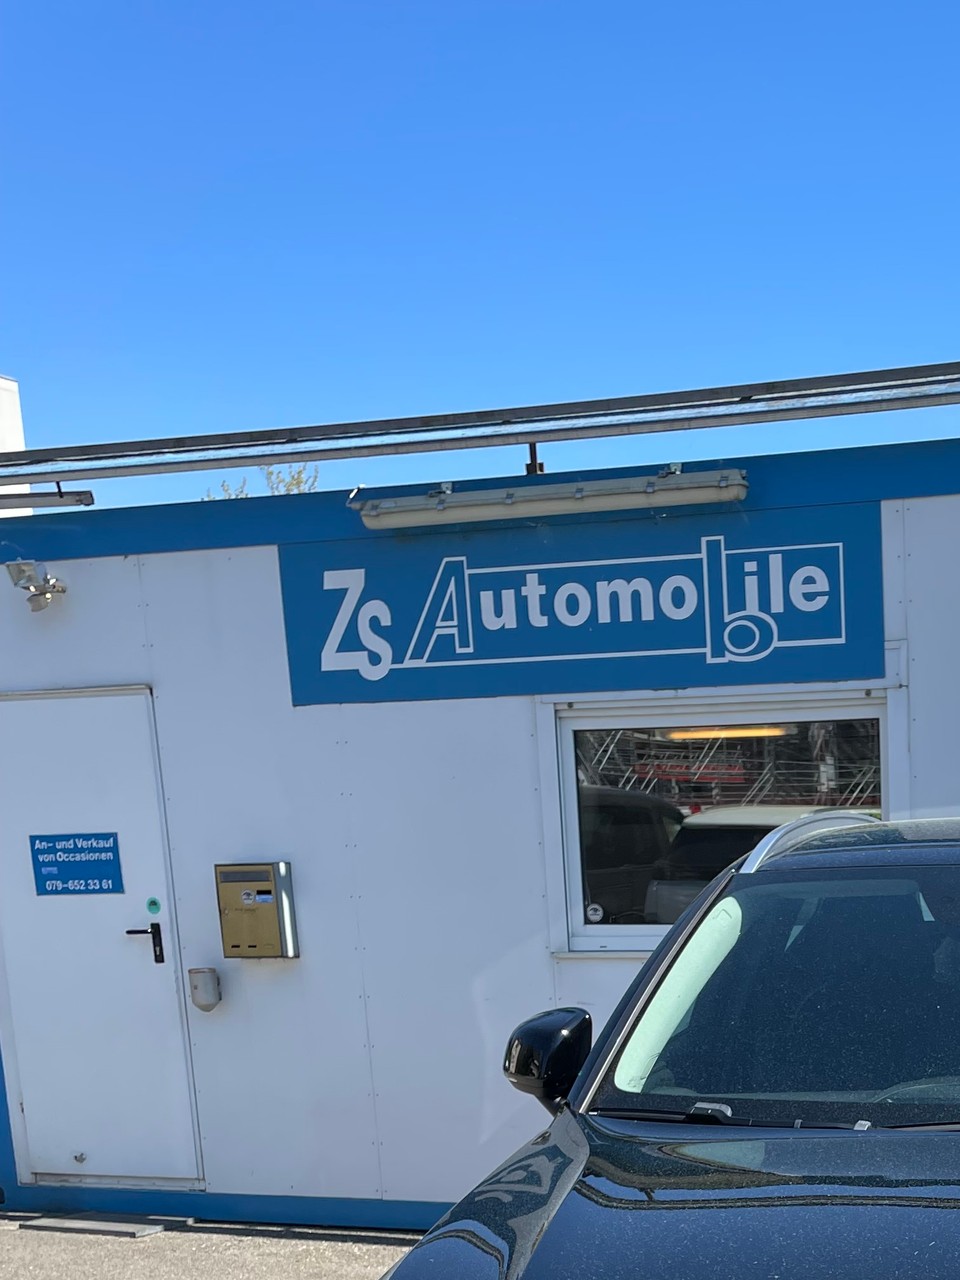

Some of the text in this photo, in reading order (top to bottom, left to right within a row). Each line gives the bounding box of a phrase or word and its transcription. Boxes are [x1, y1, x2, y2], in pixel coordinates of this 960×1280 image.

[403, 535, 831, 664] Automobile
[34, 837, 114, 850] An- und Verkauf
[38, 851, 114, 862] von Occasionen
[46, 879, 113, 891] 079-652 33 61
